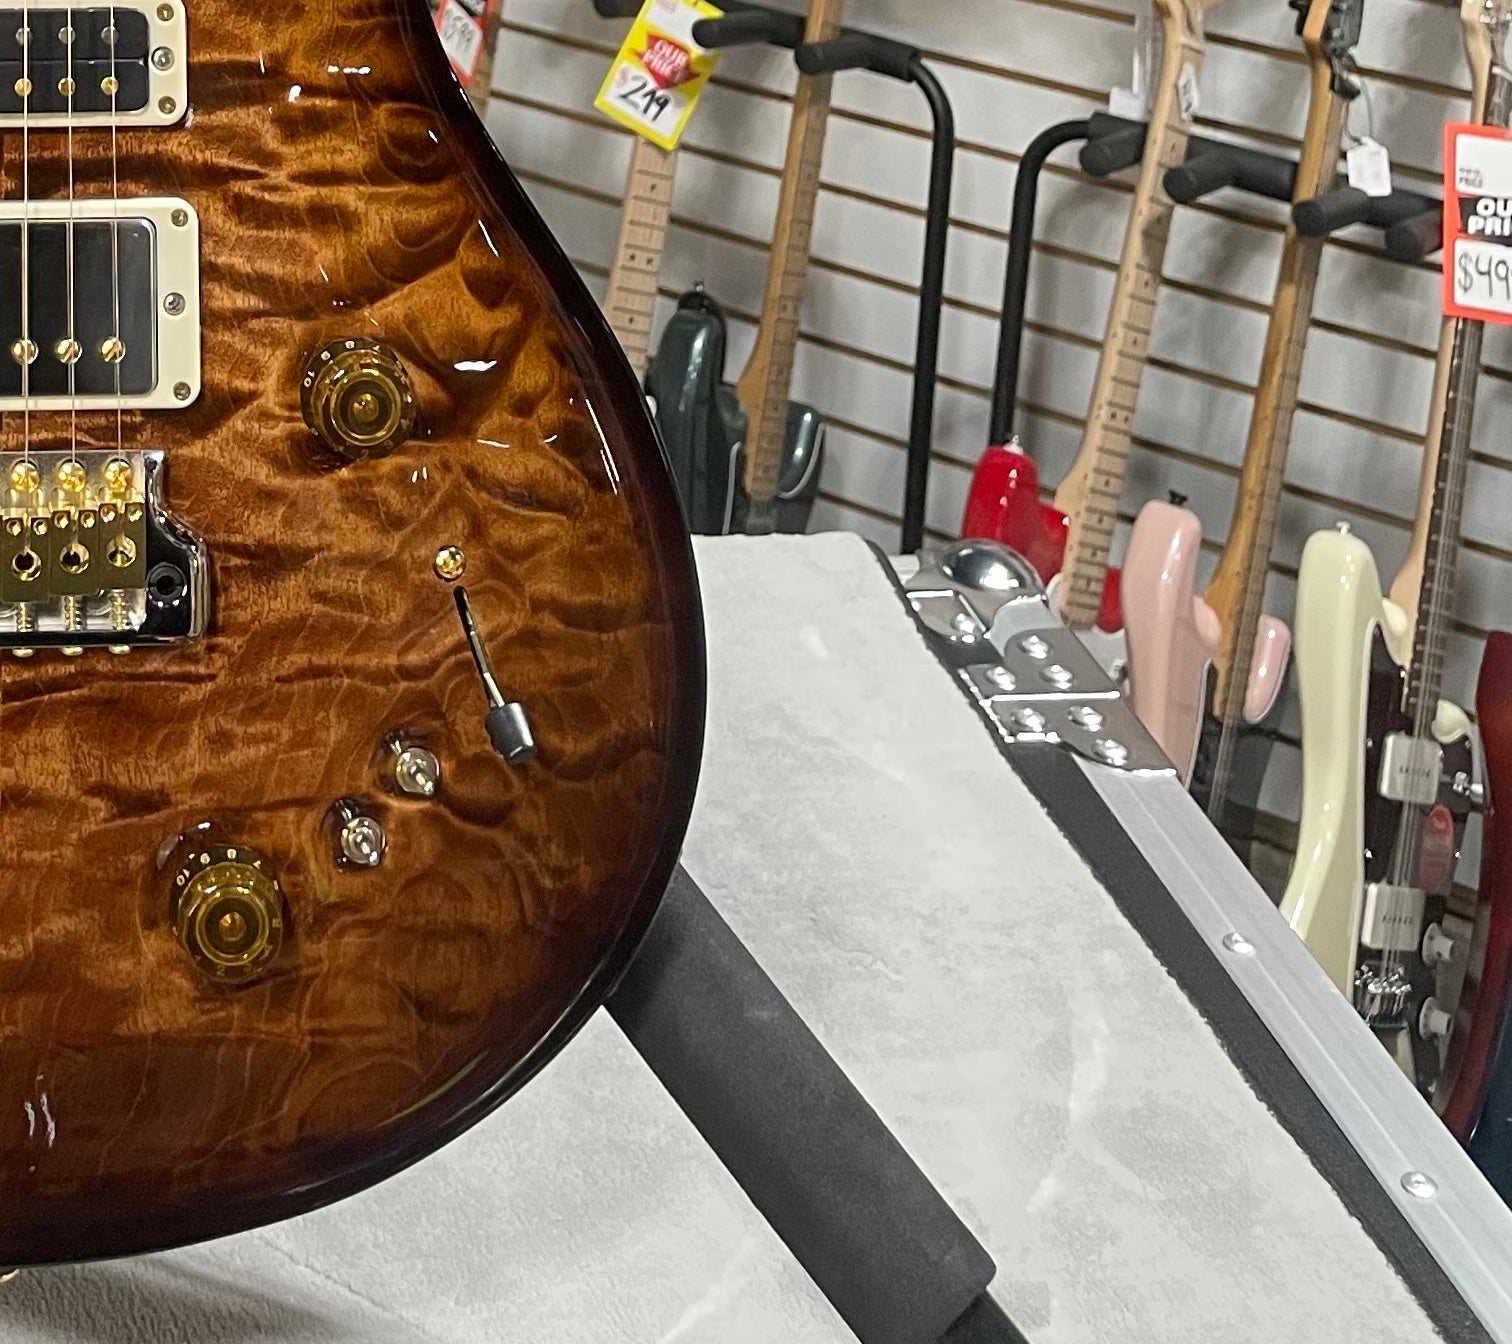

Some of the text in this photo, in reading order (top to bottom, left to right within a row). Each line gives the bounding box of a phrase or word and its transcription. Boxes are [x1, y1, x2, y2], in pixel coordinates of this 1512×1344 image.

[653, 39, 690, 64] OUR
[1476, 197, 1512, 217] OU
[1467, 214, 1512, 237] PRI
[1458, 251, 1512, 300] $49
